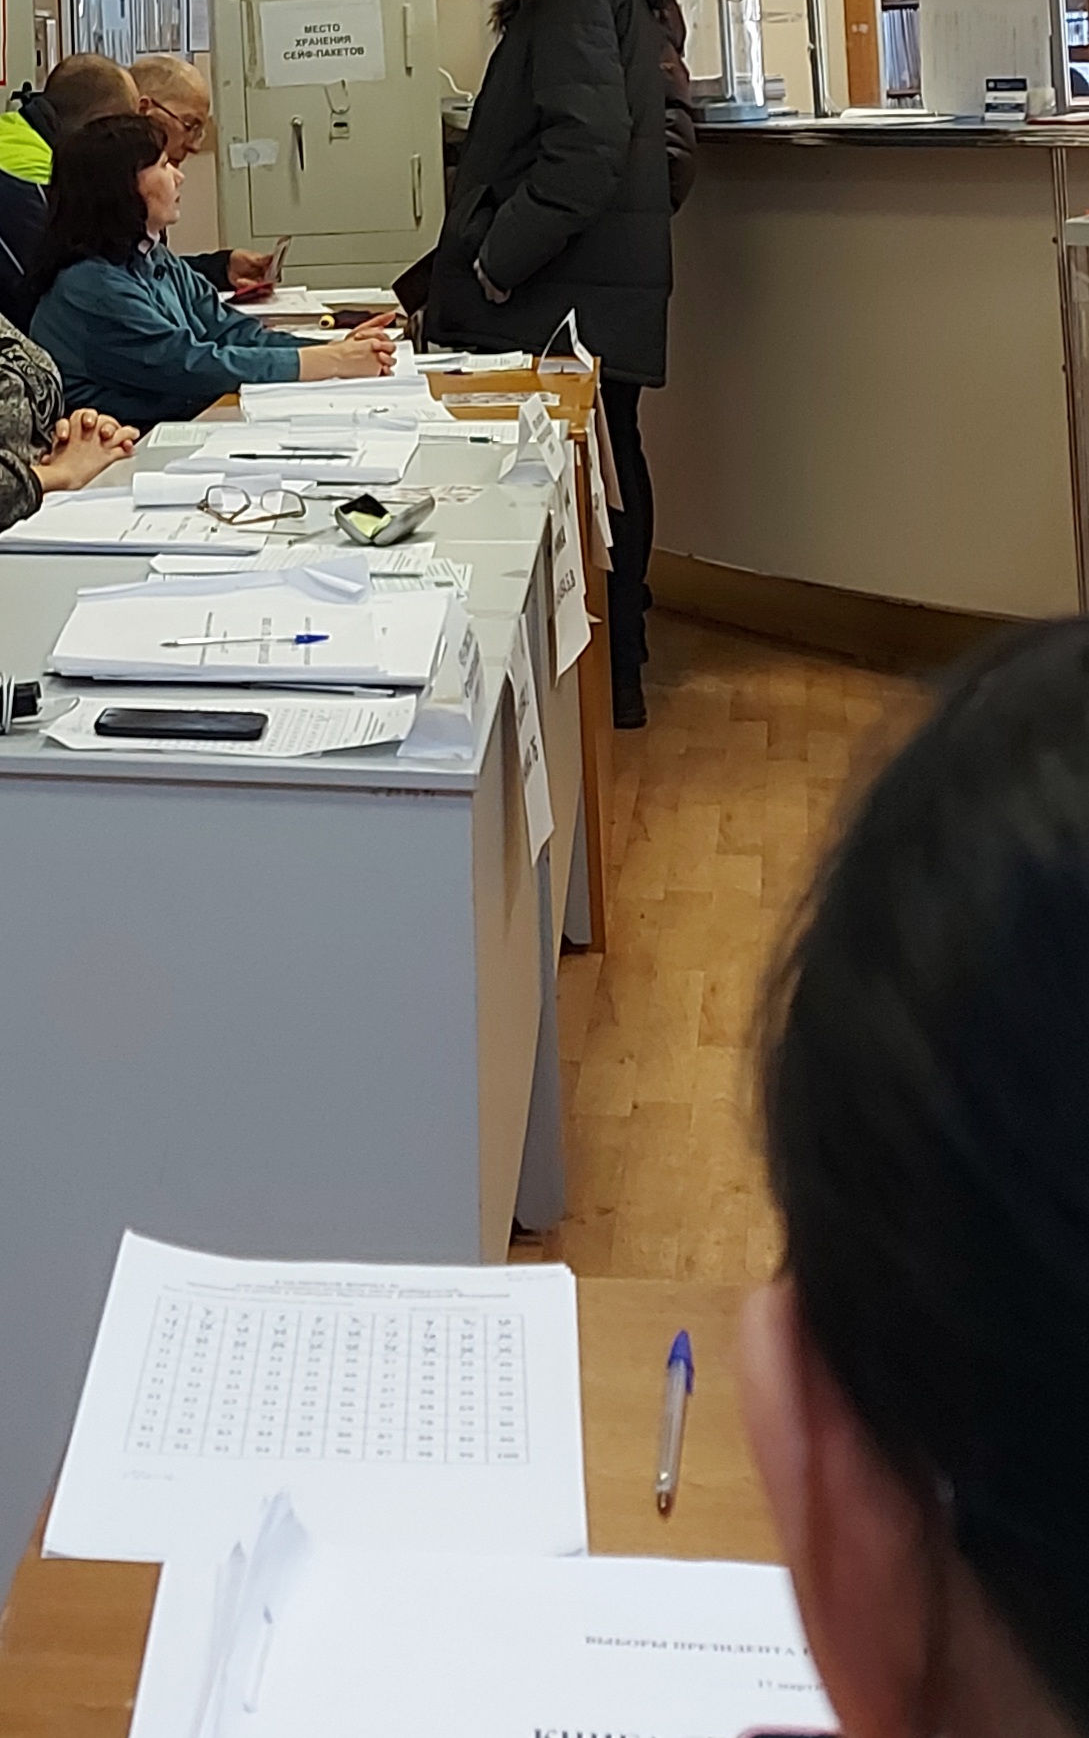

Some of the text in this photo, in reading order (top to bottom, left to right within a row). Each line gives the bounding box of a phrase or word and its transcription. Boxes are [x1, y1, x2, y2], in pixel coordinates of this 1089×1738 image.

[304, 24, 341, 34] МЕСТО
[295, 35, 352, 48] ХРАНЕНИЯ
[283, 47, 365, 61] СЕЙФ-ПАКЕТОВ
